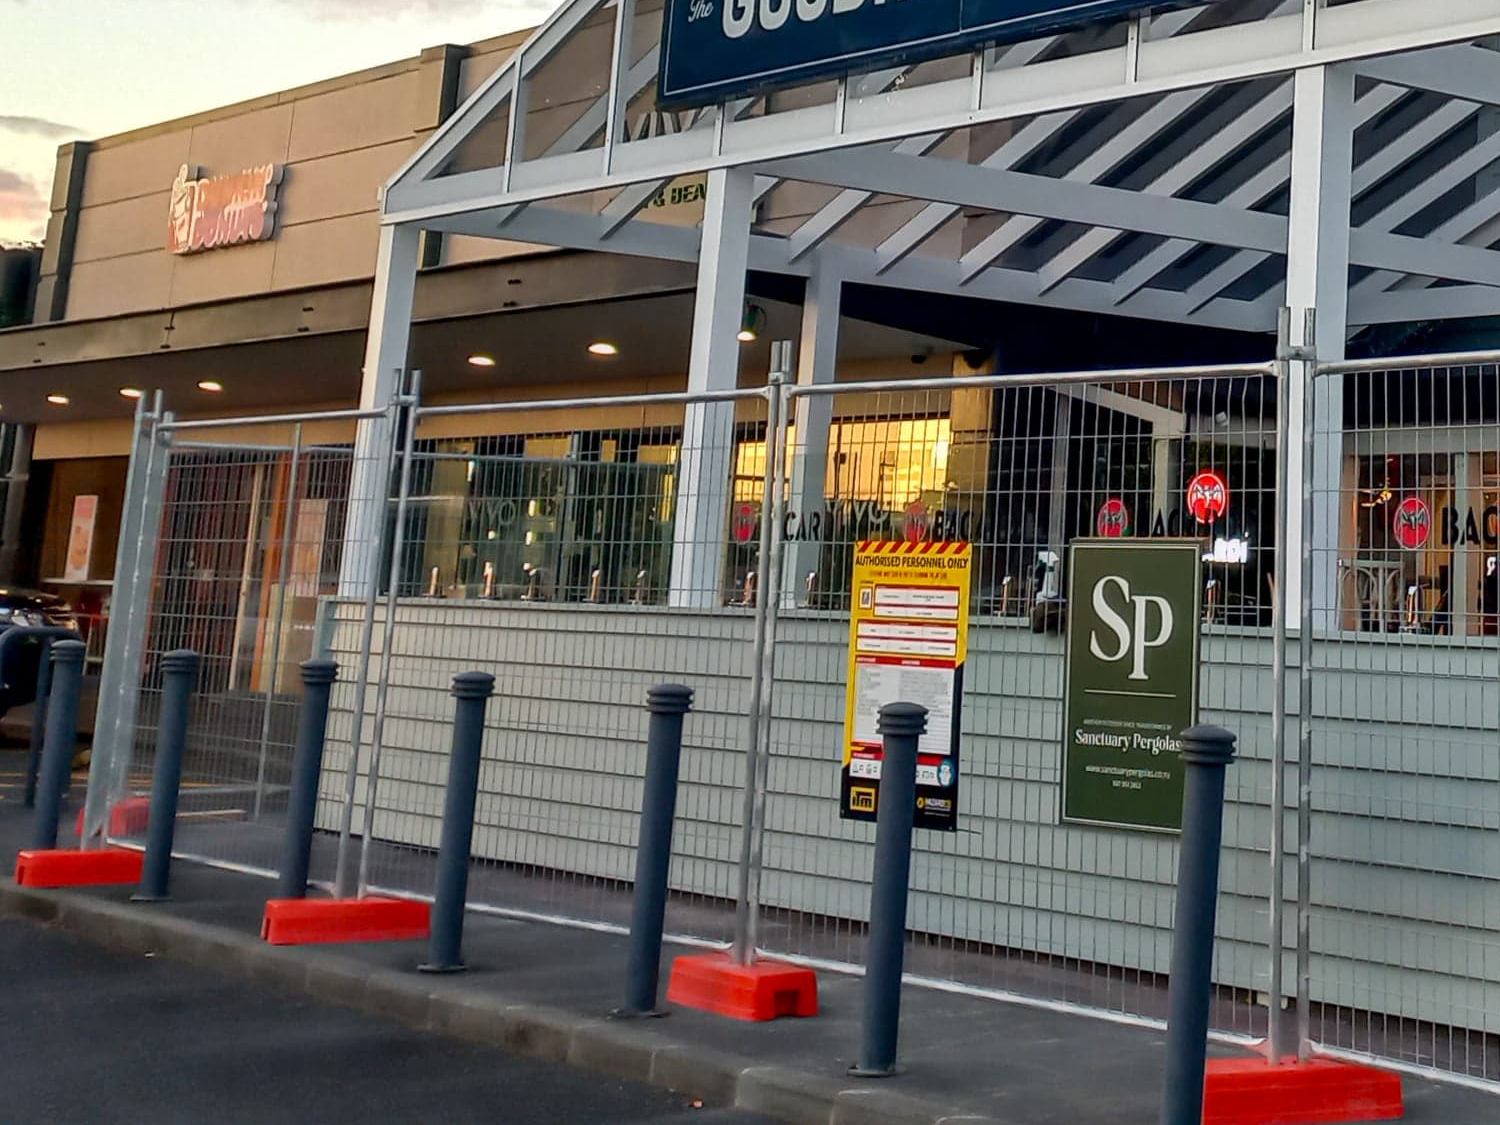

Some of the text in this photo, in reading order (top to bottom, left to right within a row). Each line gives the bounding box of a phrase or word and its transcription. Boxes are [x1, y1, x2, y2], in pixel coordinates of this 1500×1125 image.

[902, 556, 946, 569] PERSONNEL
[947, 558, 969, 569] ONLY
[1090, 575, 1173, 679] SP
[1075, 728, 1183, 756] Sanctuary Pergolas
